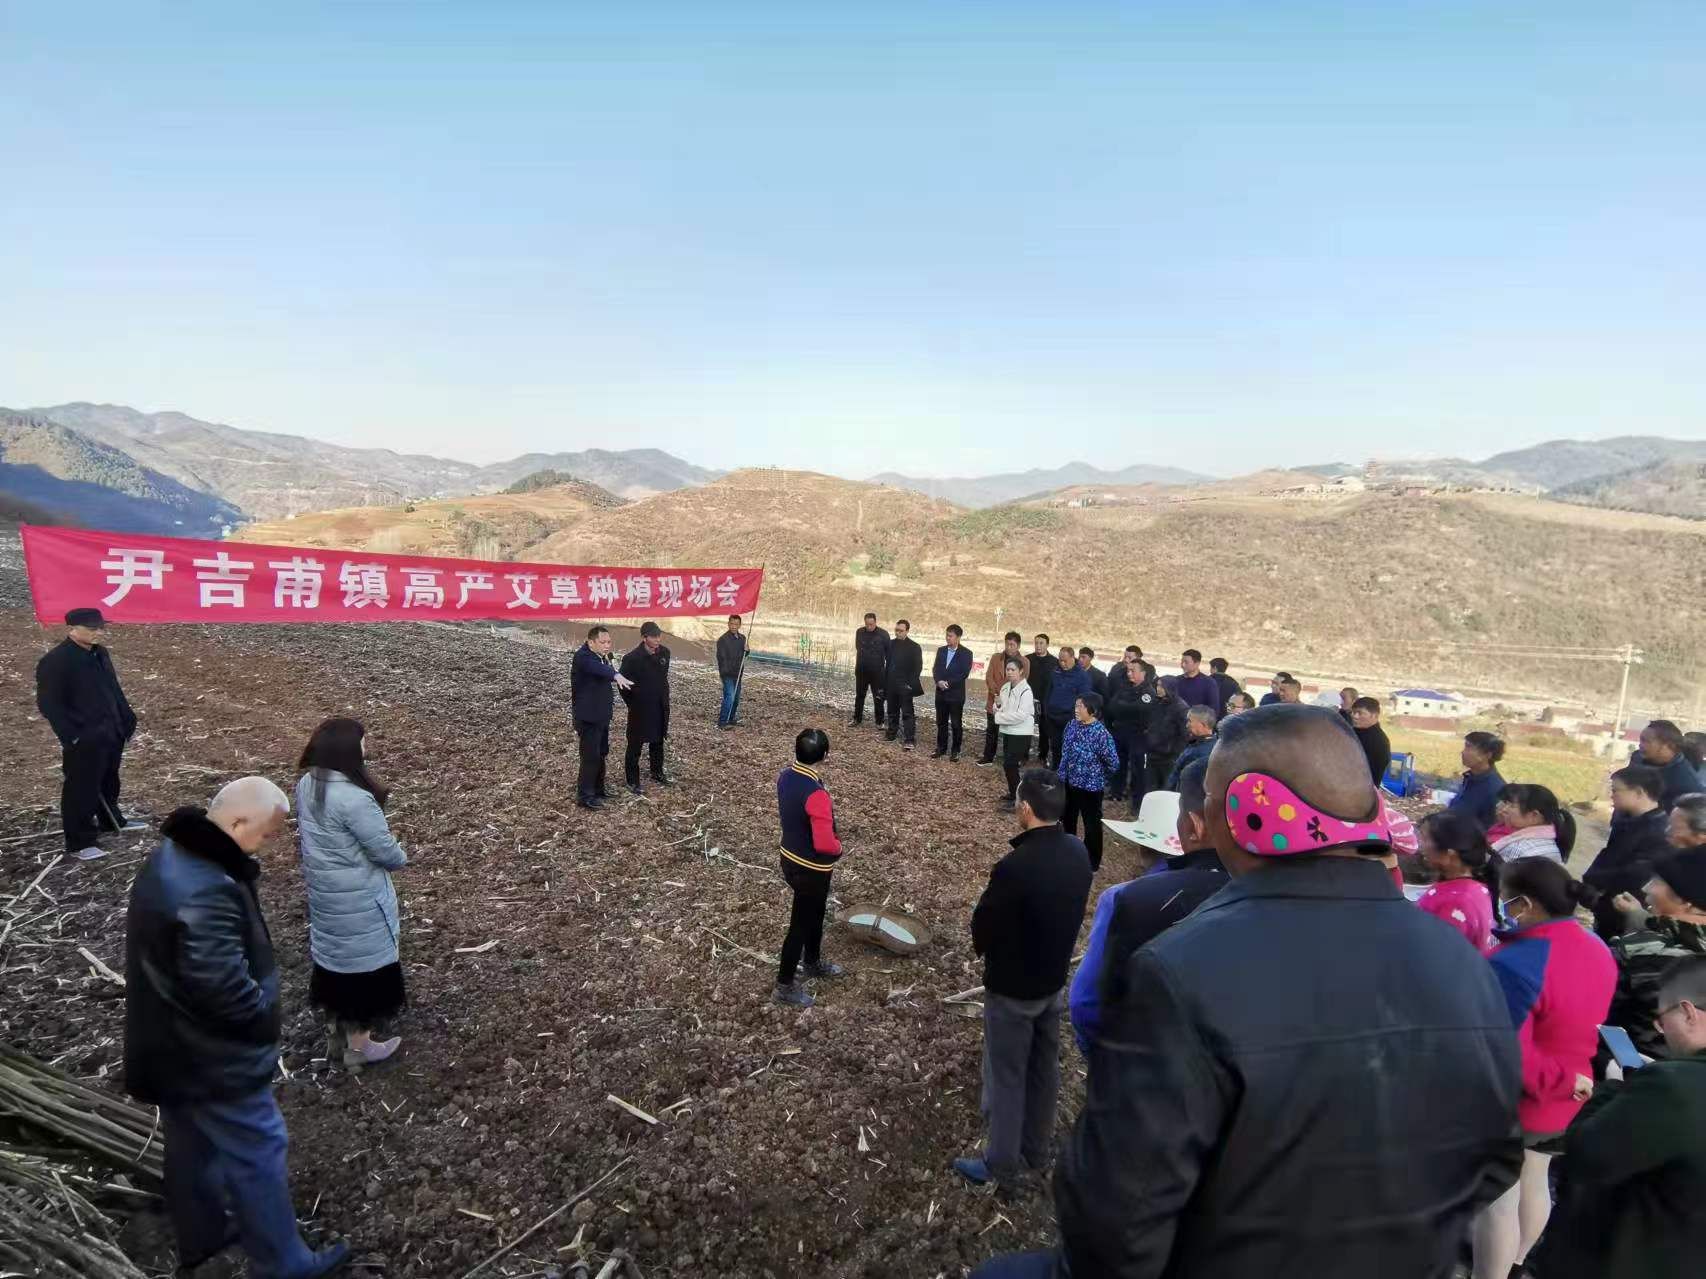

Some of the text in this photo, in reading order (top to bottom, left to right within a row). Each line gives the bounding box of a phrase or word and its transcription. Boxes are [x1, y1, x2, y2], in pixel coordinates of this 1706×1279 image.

[100, 548, 741, 609] 尹吉甫镇高产艾草种植现场会
